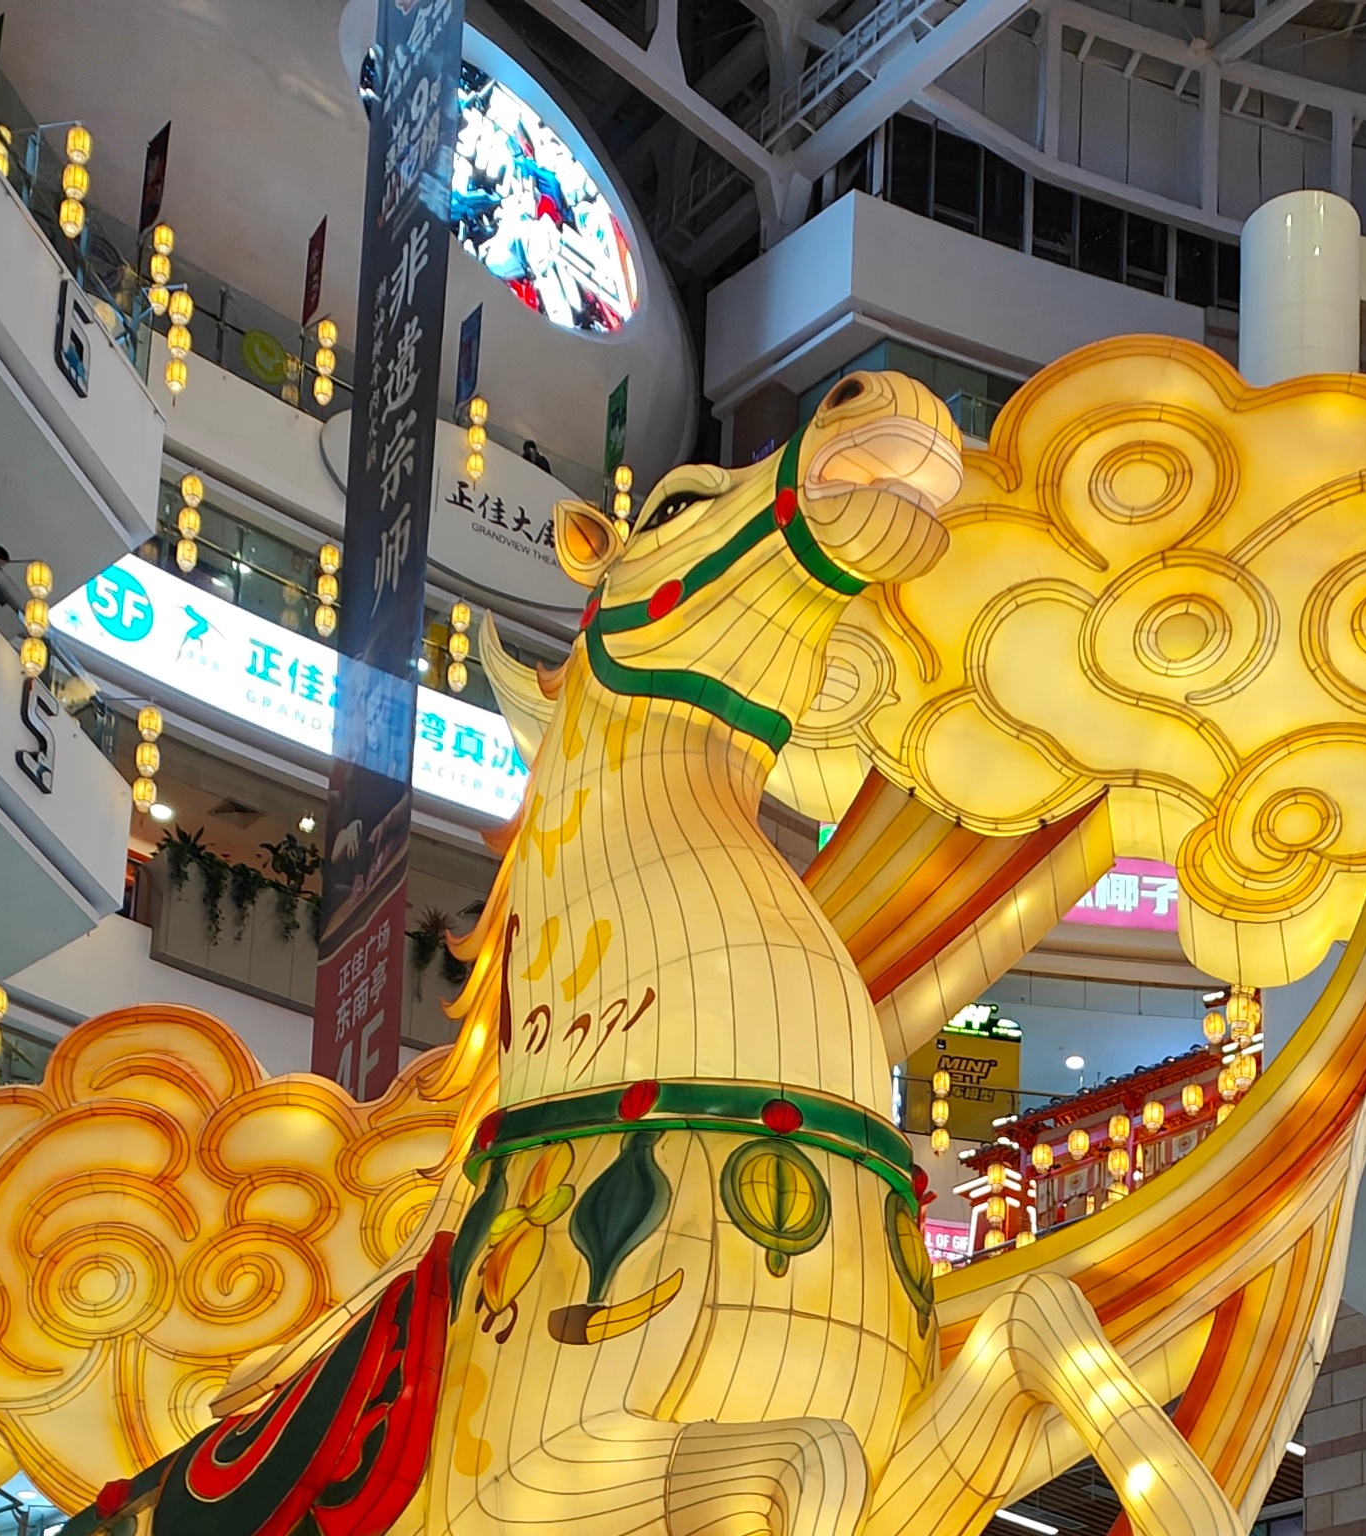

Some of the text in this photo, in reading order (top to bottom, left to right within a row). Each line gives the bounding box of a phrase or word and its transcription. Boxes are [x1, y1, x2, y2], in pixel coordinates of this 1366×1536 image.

[371, 221, 430, 619] 非遗宗师
[471, 522, 561, 569] GRANDVIEW THEA
[91, 574, 149, 629] 5F
[15, 675, 58, 795] 5
[337, 918, 392, 997] 正佳广场
[335, 957, 387, 1043] 东南亭
[938, 1056, 992, 1074] MINI
[936, 1232, 950, 1248] OF
